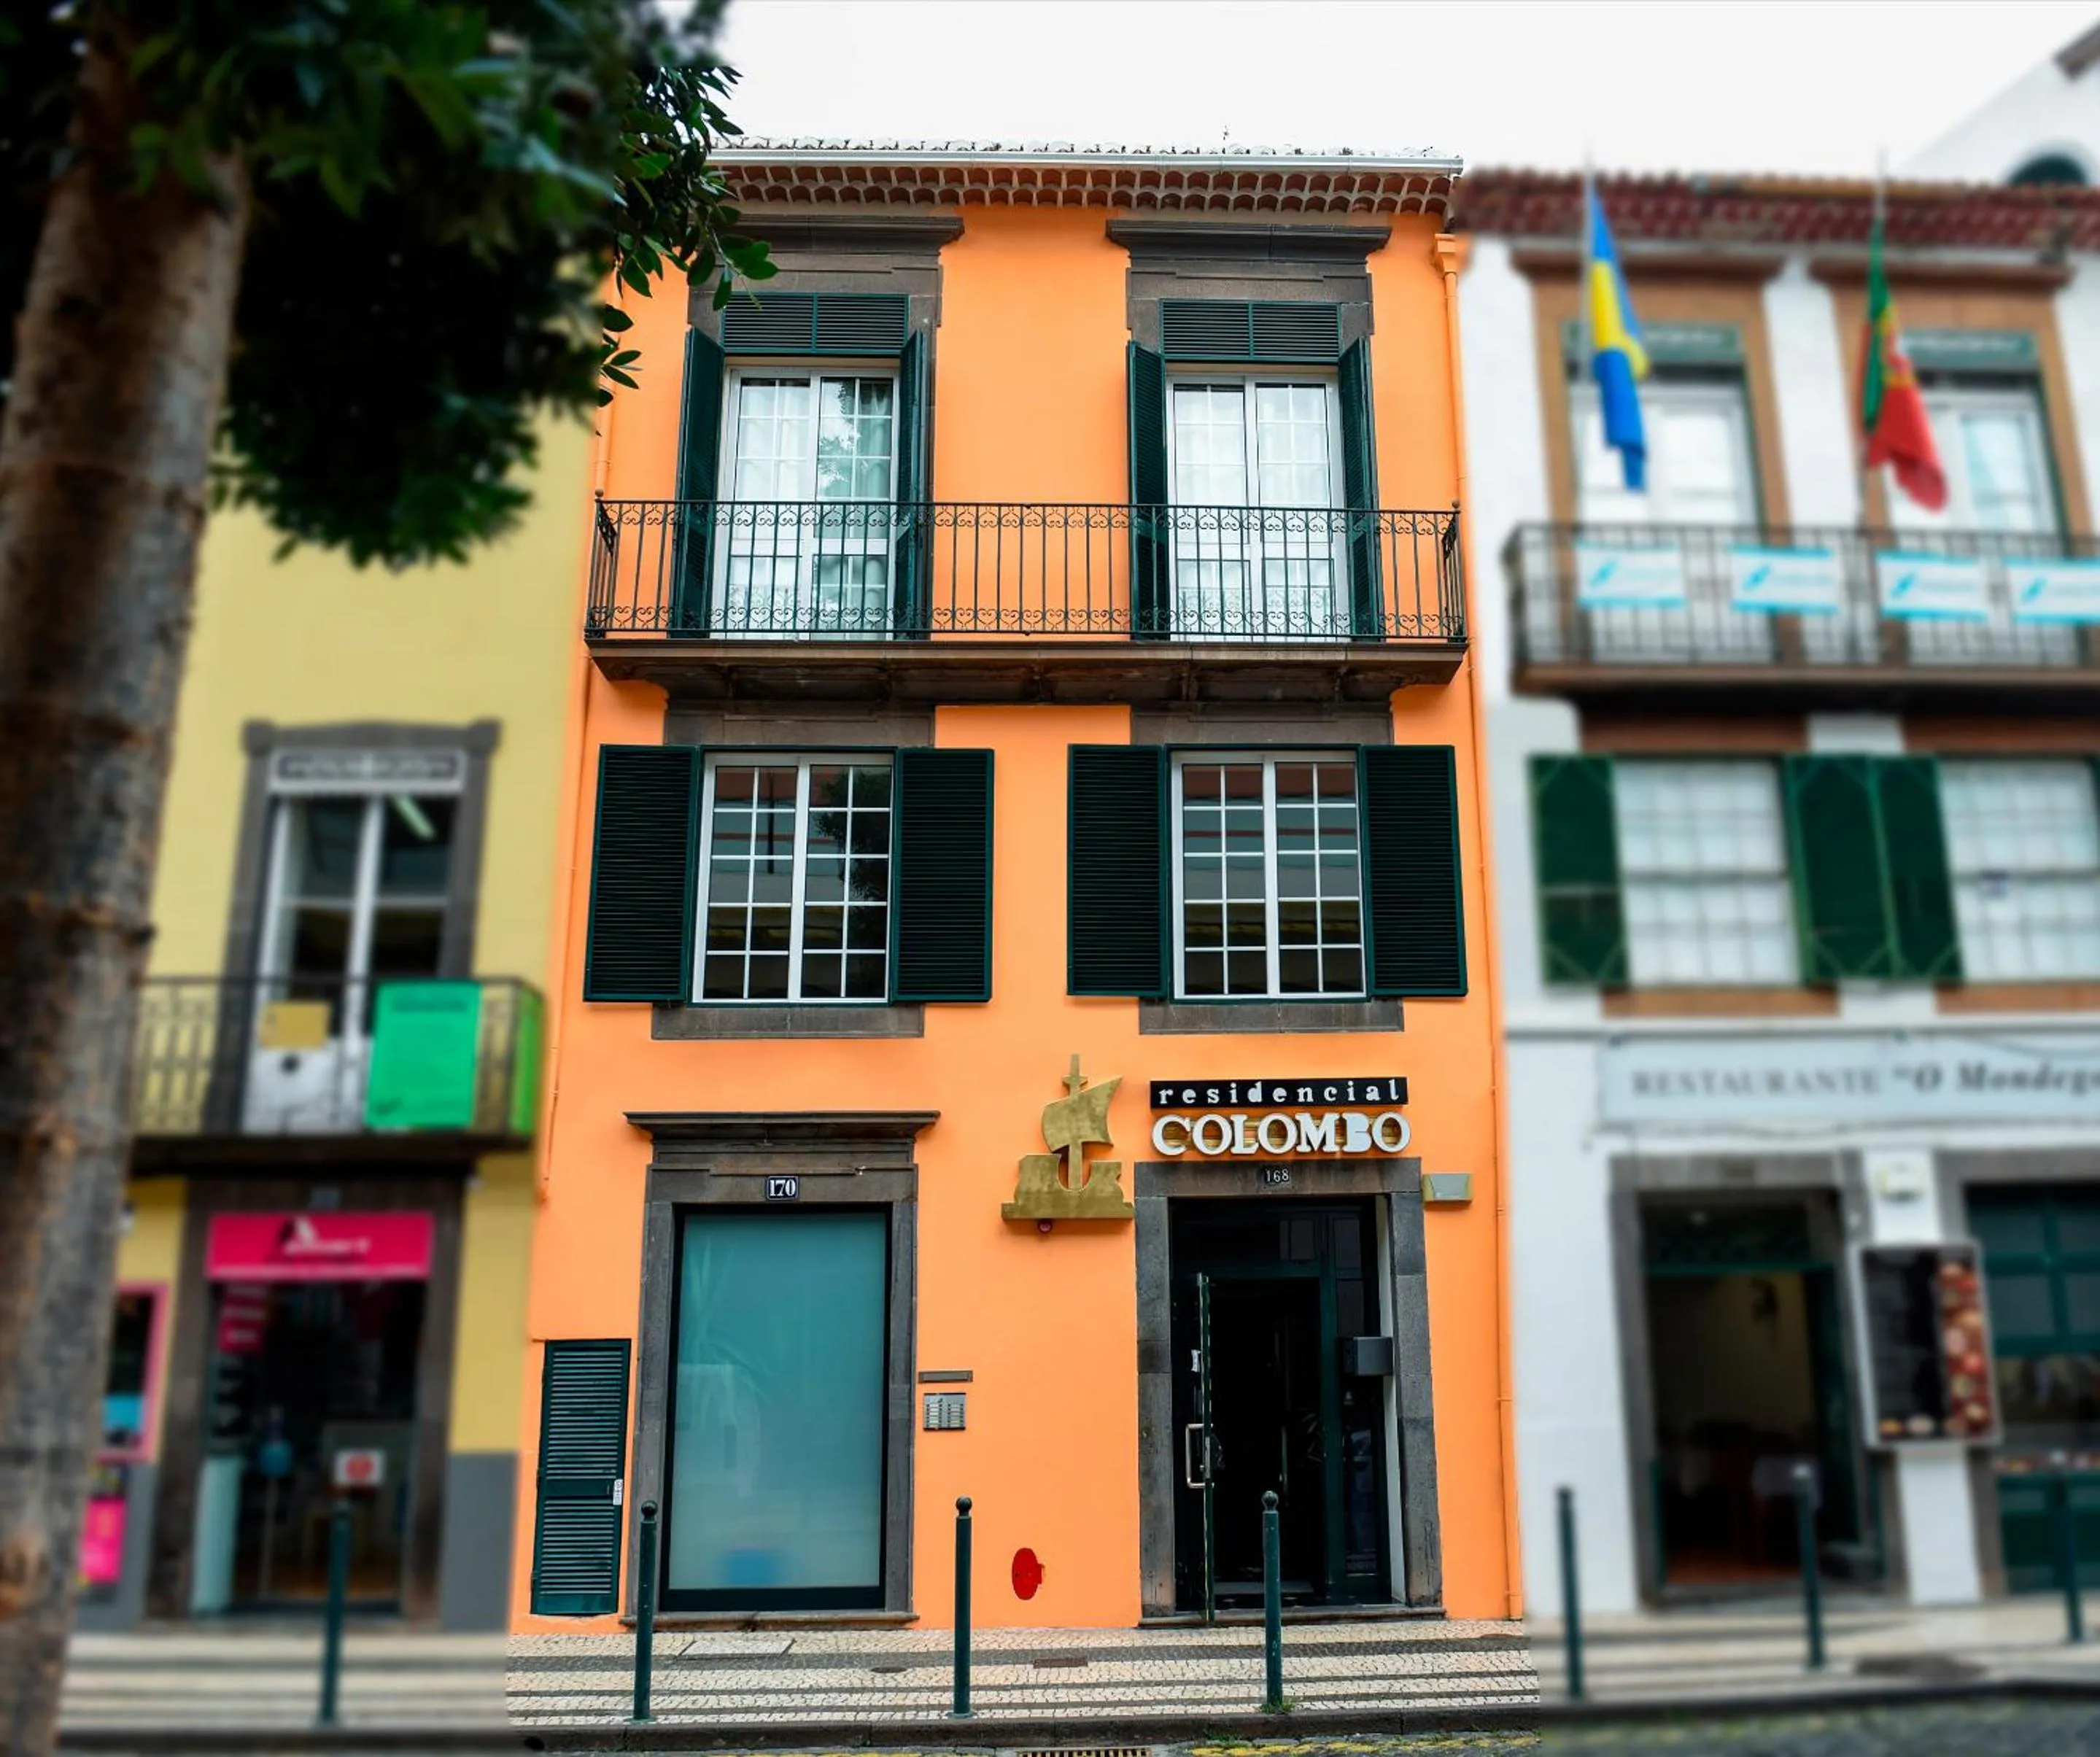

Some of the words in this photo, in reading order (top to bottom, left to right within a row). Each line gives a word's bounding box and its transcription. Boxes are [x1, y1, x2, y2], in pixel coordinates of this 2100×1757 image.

[1159, 1079, 1399, 1104] residencial
[1633, 1068, 1880, 1095] RESTAURANTE
[1152, 1112, 1411, 1155] COLOMBO
[1266, 1168, 1289, 1182] 168
[770, 1179, 797, 1197] 170
